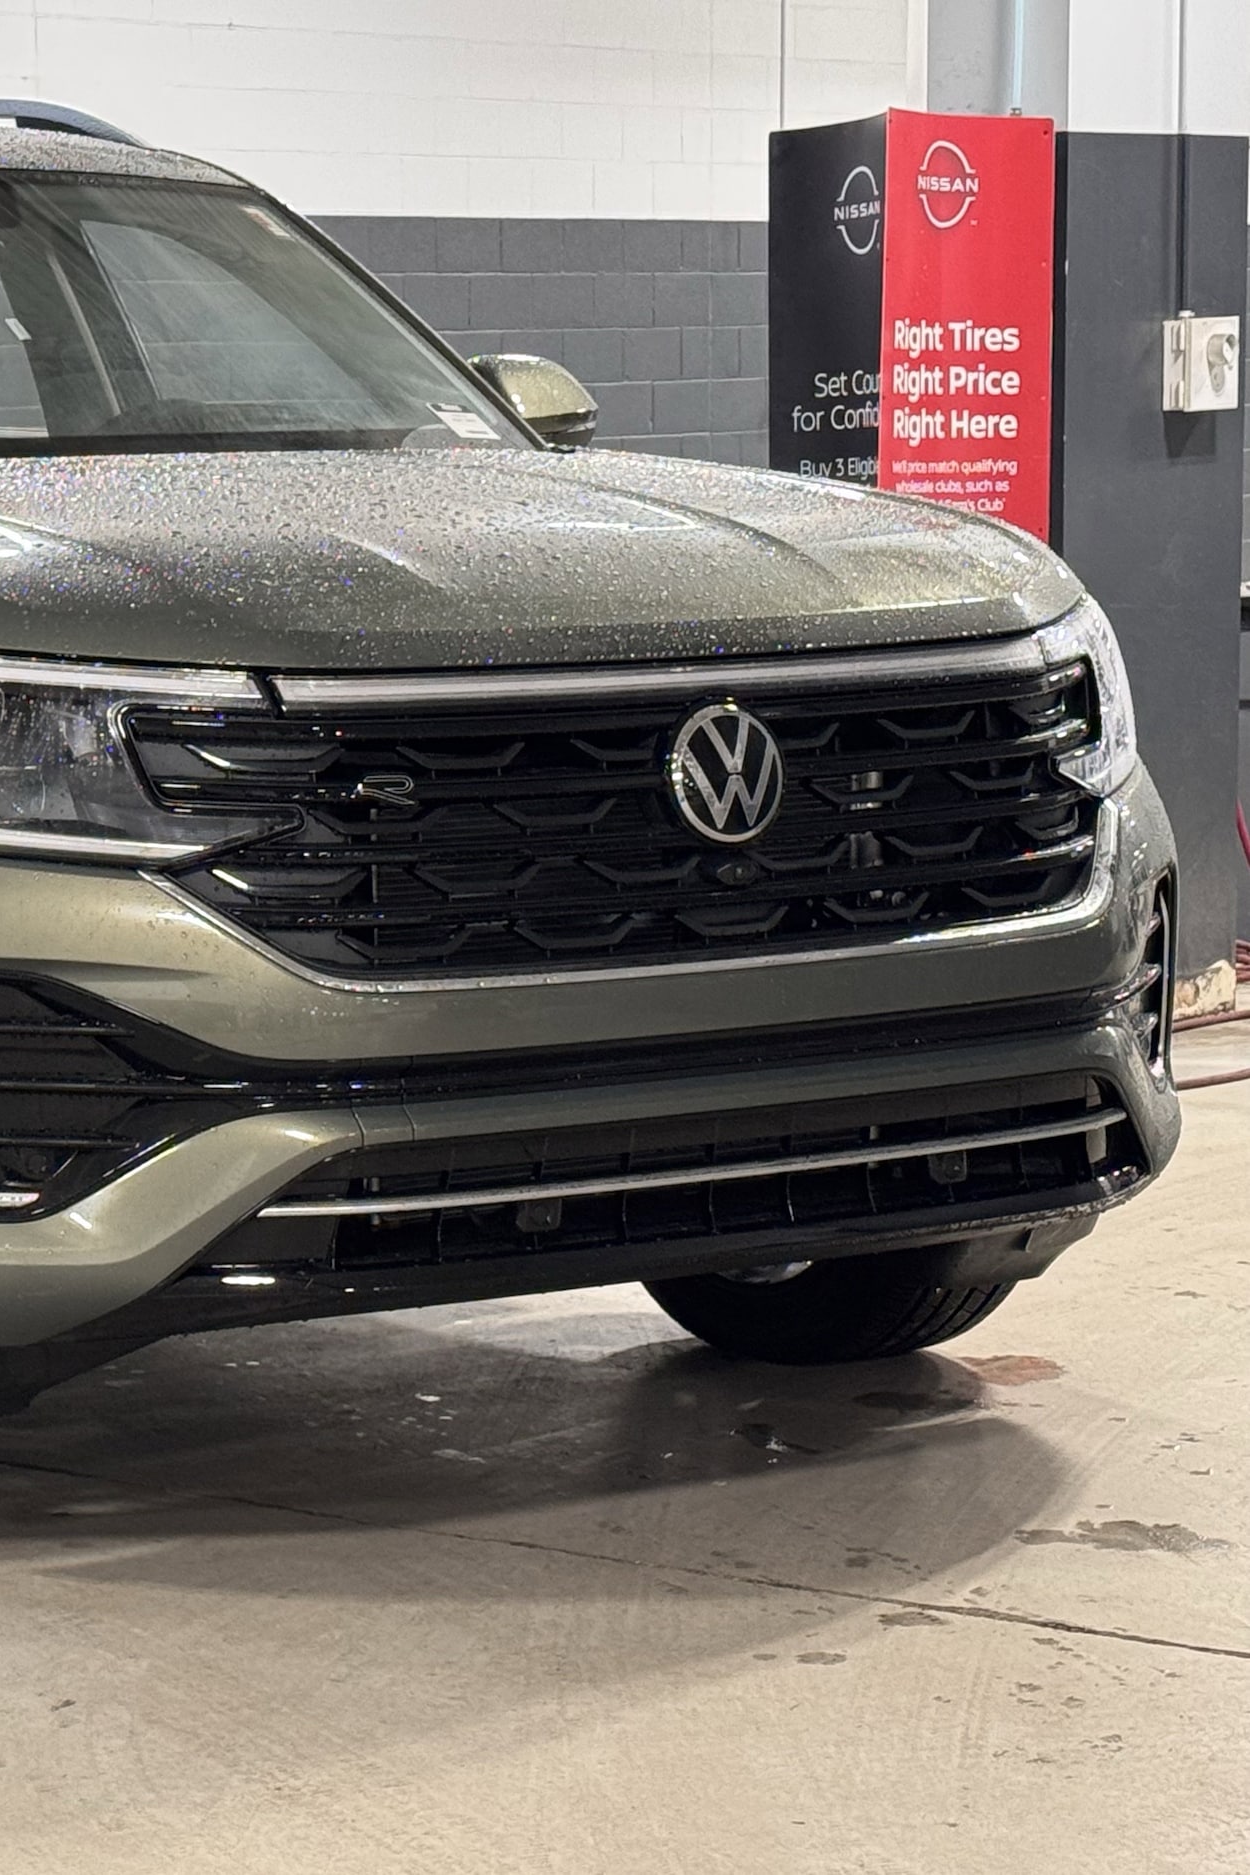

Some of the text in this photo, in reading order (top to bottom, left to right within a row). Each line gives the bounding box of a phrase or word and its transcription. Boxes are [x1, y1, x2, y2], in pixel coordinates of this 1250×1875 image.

[917, 174, 979, 193] NISSAN
[834, 200, 881, 221] NISSAN
[893, 317, 1021, 359] Right Tires
[814, 372, 848, 398] Set
[893, 362, 1021, 403] Right Price
[791, 405, 825, 433] for
[893, 406, 1019, 447] Right Here
[799, 459, 832, 478] Buy
[835, 458, 845, 477] 3
[928, 459, 959, 474] match
[961, 459, 1018, 476] qualifying
[895, 479, 934, 493] wholesale
[965, 479, 993, 494] such
[995, 482, 1010, 493] as
